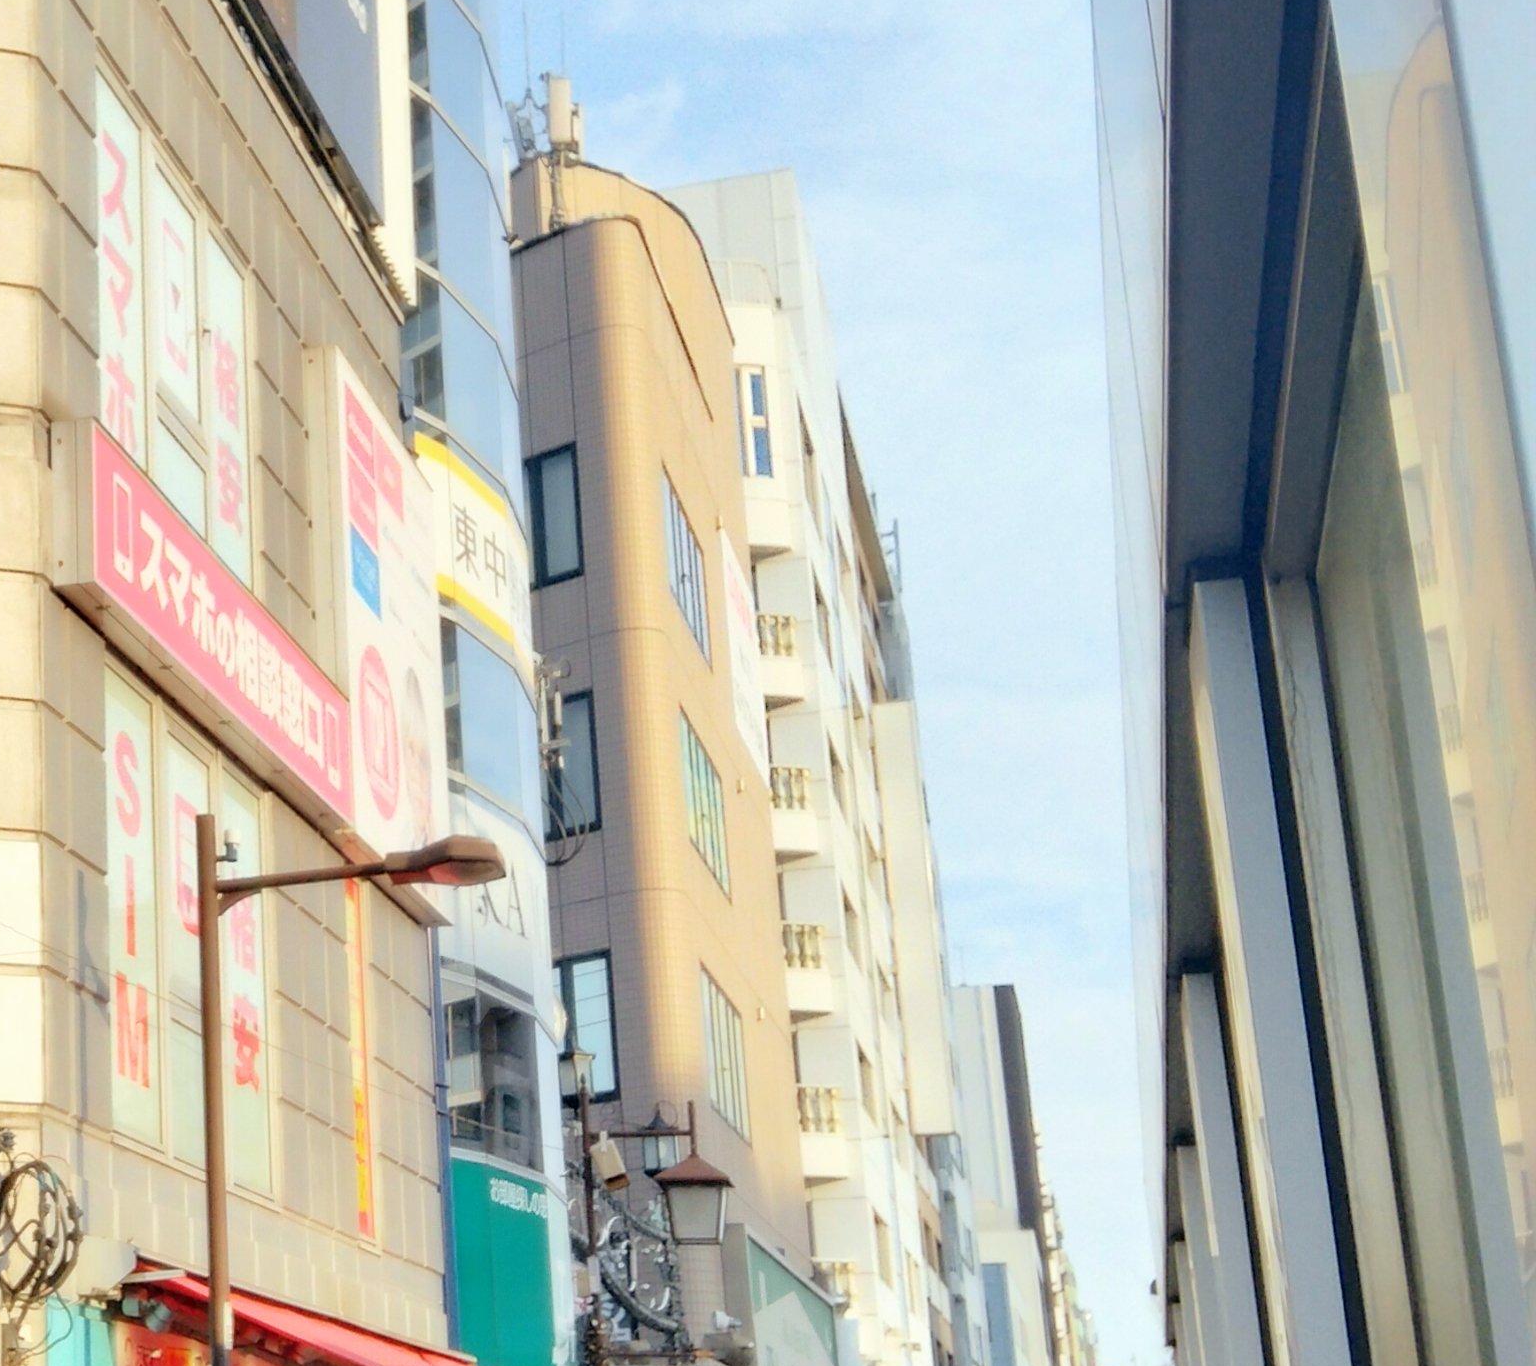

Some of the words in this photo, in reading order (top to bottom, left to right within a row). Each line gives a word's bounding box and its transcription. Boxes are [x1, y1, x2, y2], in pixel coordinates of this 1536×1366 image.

[101, 129, 136, 457] スマホ
[114, 730, 151, 1089] SIM
